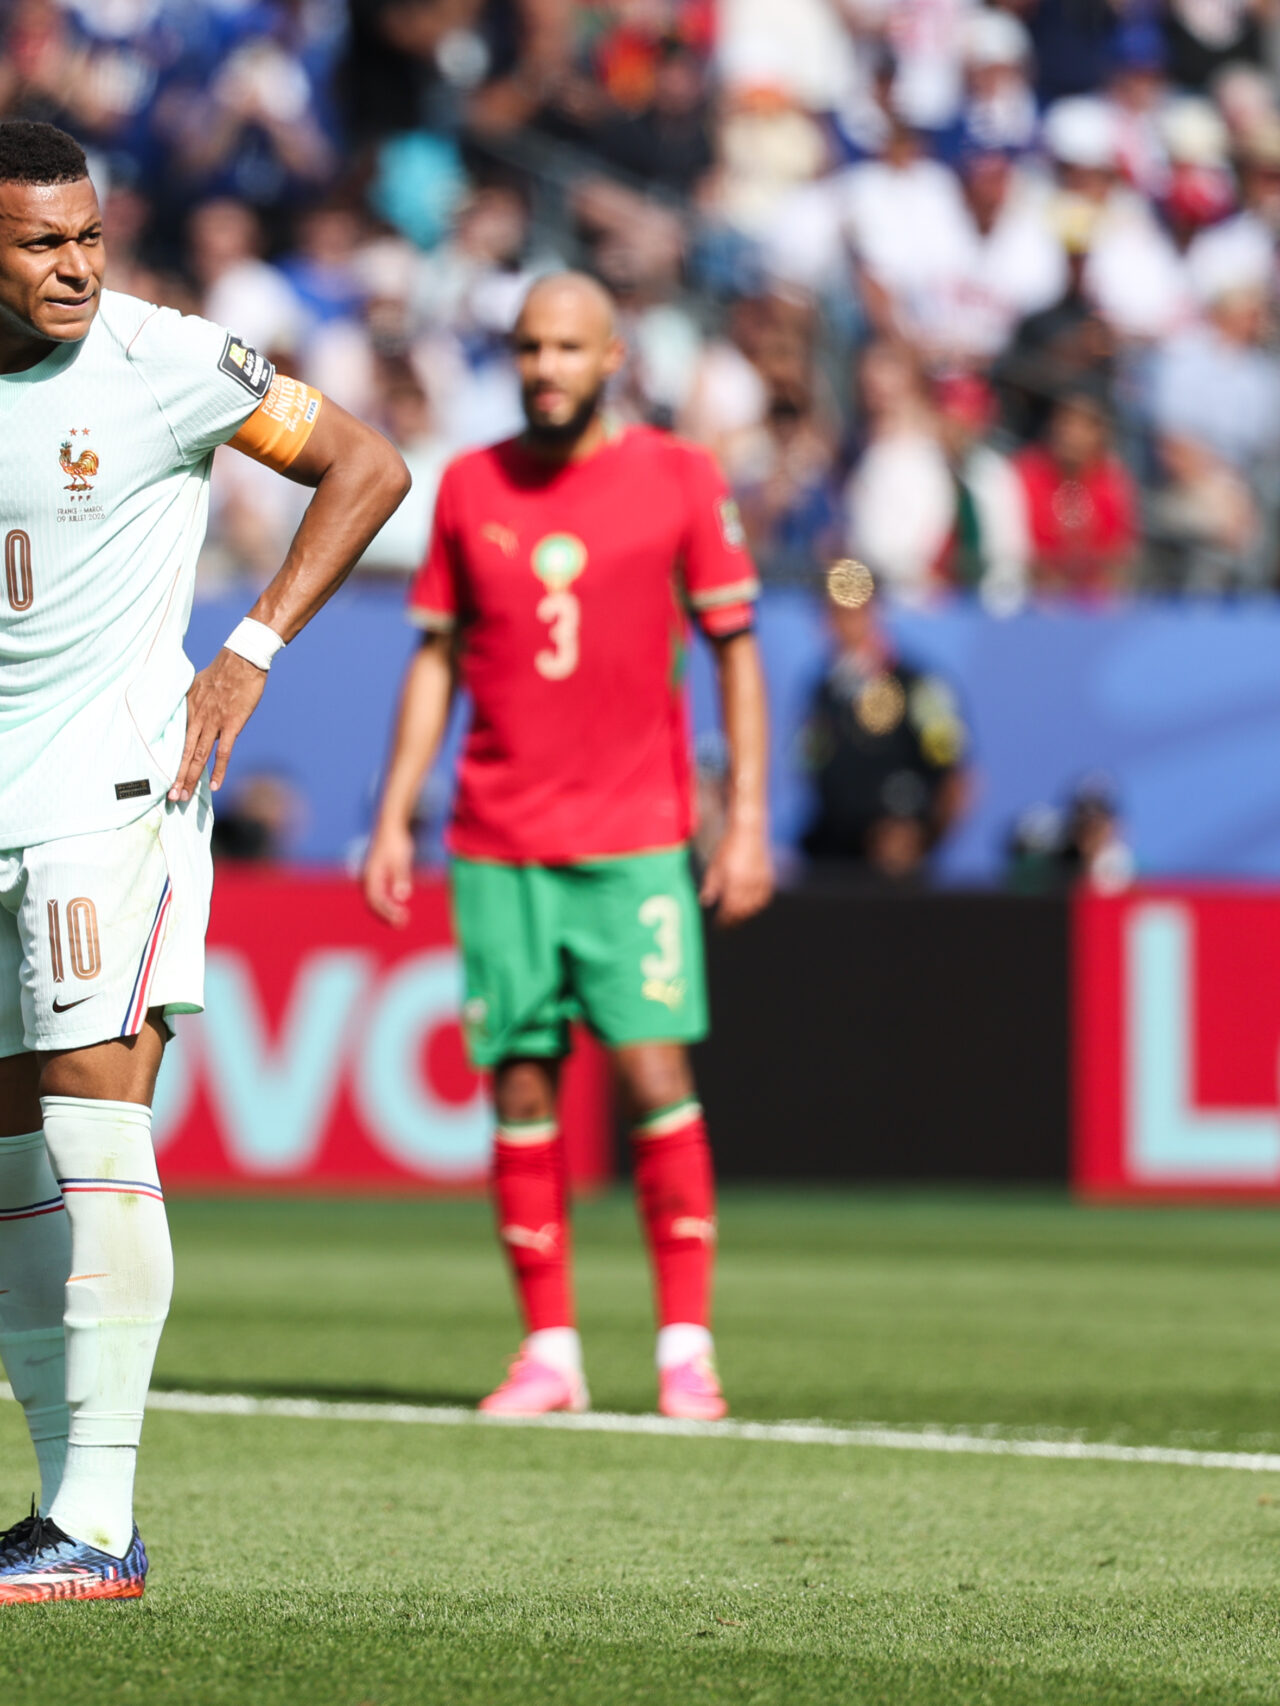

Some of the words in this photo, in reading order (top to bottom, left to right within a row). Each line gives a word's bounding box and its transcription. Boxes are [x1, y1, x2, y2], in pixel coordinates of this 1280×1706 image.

[306, 401, 316, 420] FIFA
[57, 507, 77, 515] FRANCE
[83, 505, 104, 513] MAROC
[57, 515, 66, 523] 09
[69, 514, 87, 522] JUILLET
[88, 513, 106, 521] 2026
[534, 592, 580, 681] 3
[47, 896, 101, 983] 10
[638, 894, 682, 981] 3
